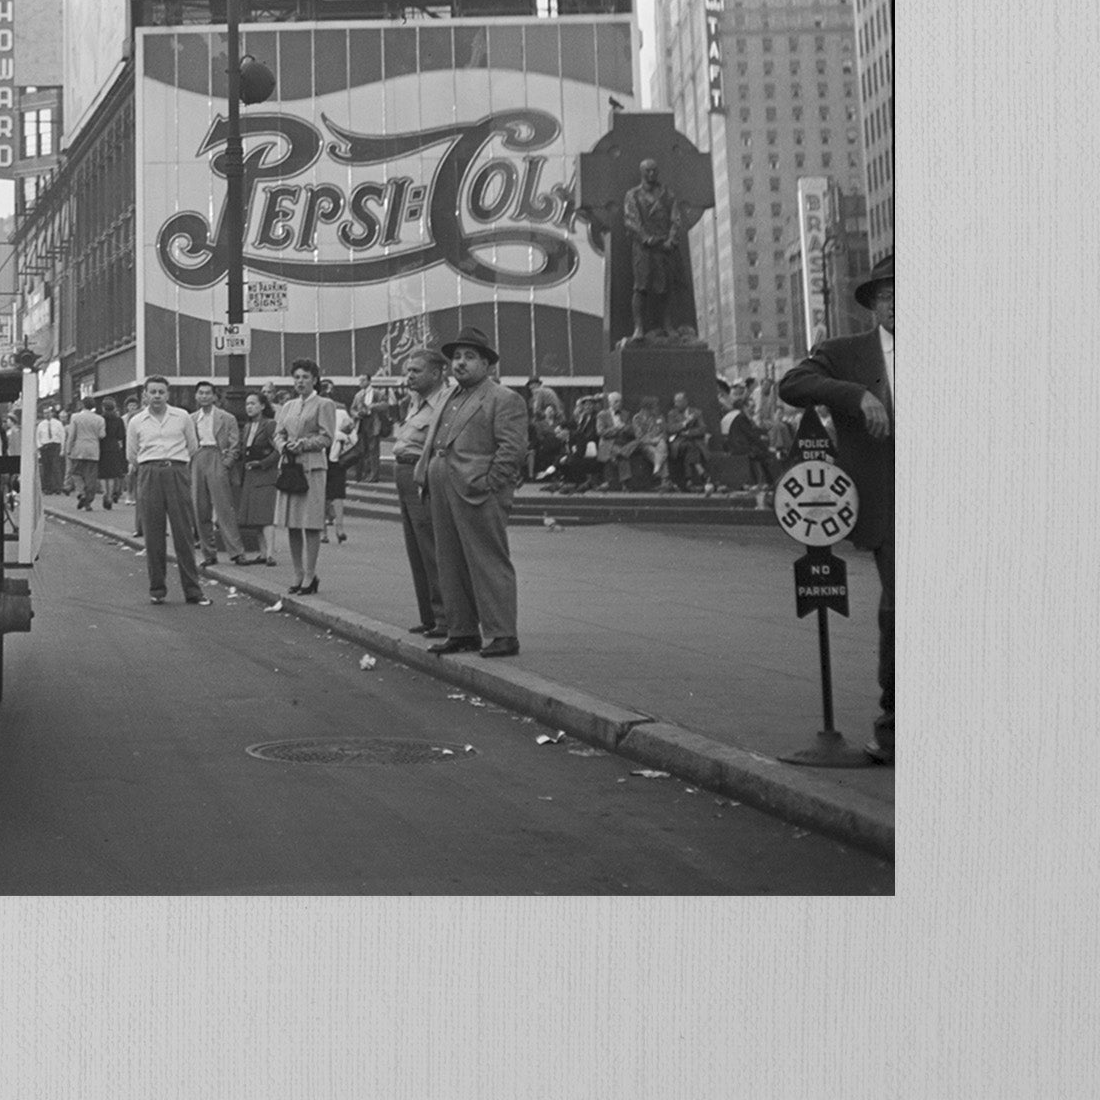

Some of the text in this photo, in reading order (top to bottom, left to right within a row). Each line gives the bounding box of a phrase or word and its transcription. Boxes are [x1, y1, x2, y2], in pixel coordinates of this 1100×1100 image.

[215, 336, 225, 350] U
[798, 439, 830, 449] POLICE
[783, 468, 852, 499] BUS
[782, 505, 854, 538] STOP
[811, 565, 831, 575] NO
[798, 585, 846, 596] PARKING
